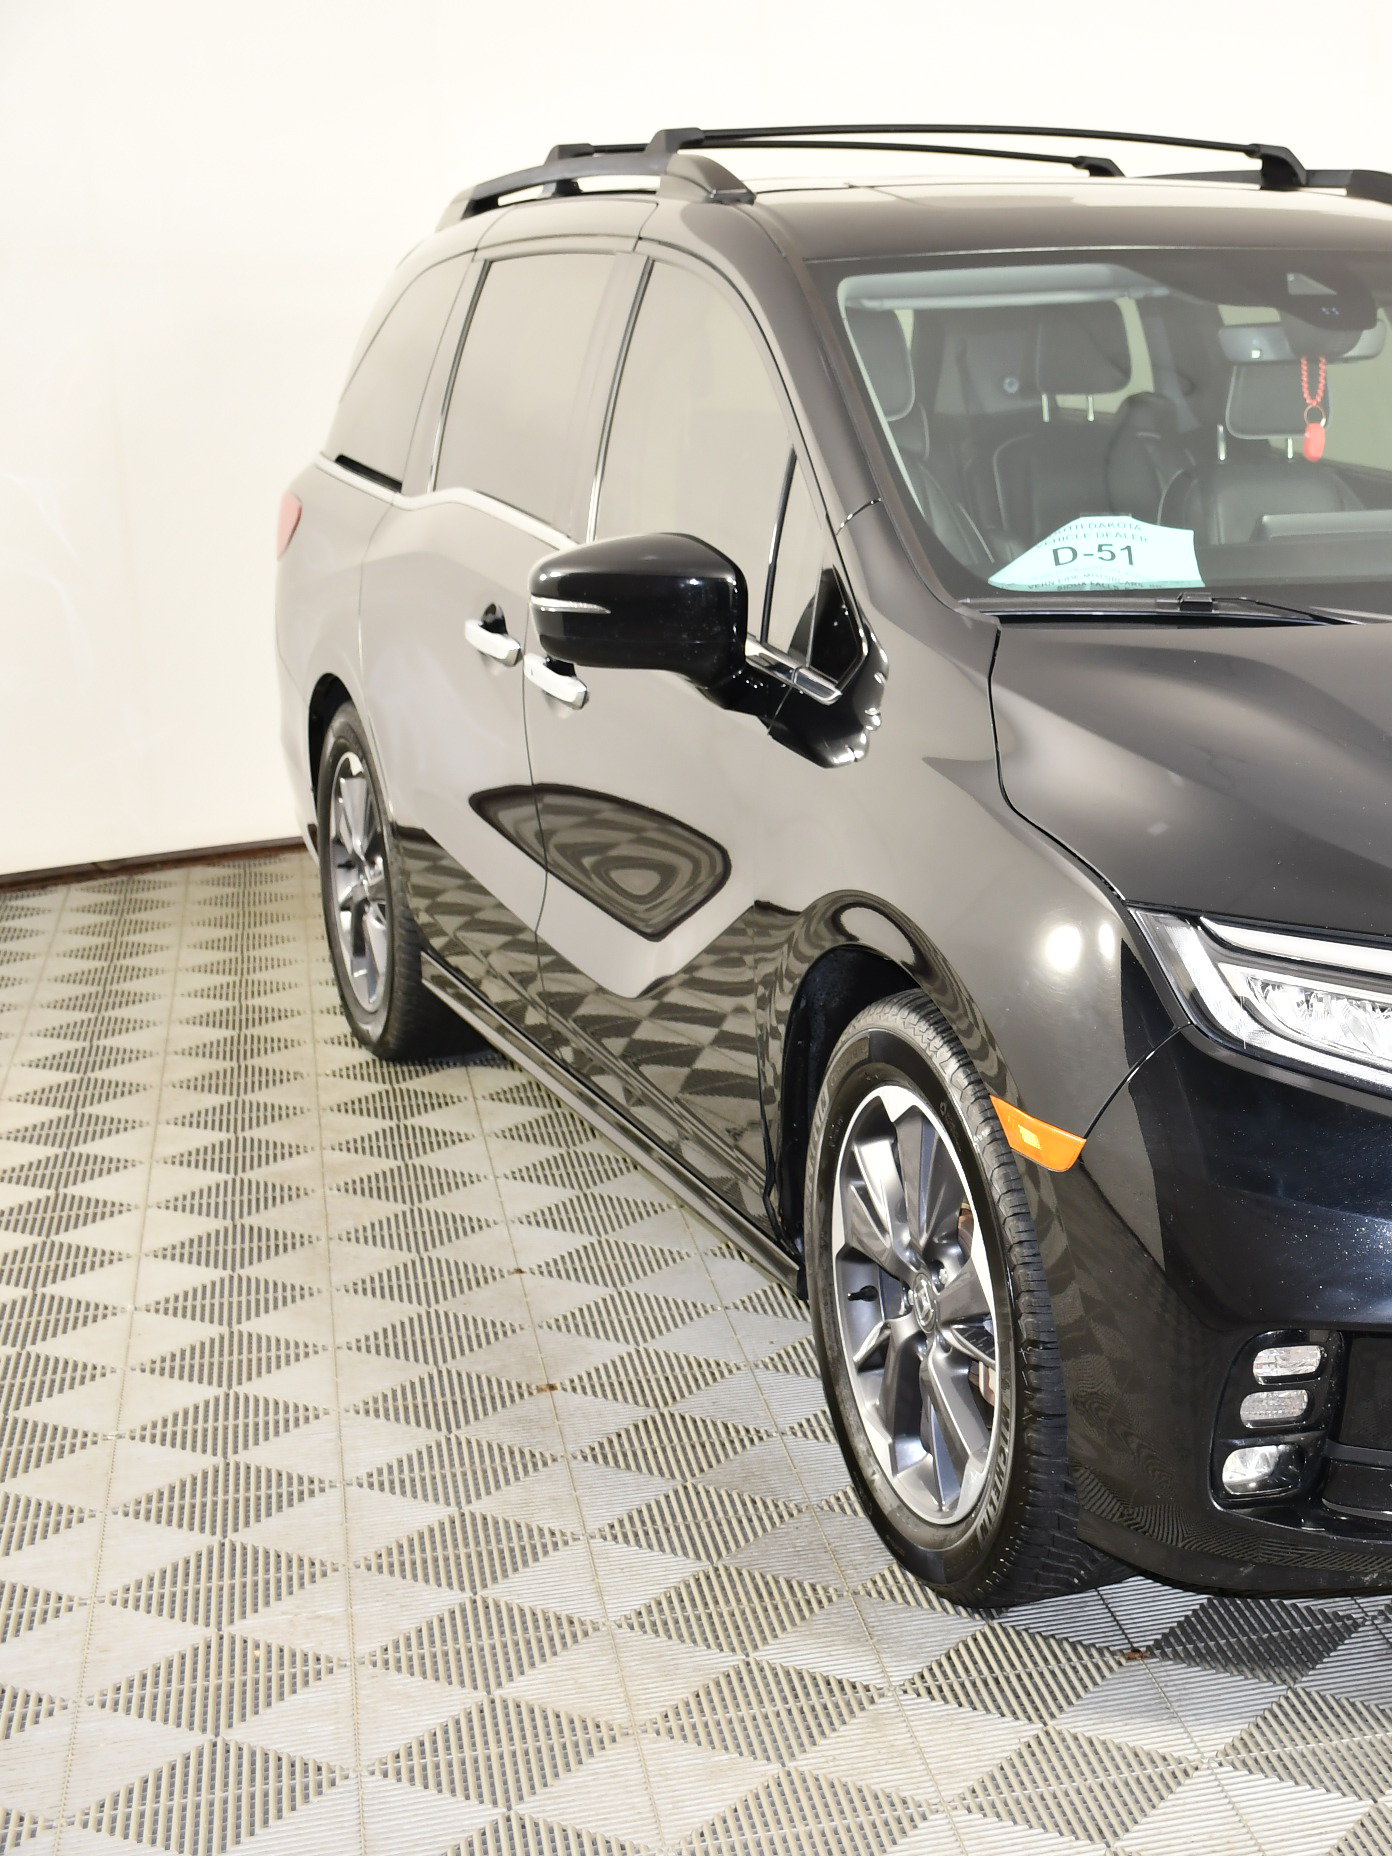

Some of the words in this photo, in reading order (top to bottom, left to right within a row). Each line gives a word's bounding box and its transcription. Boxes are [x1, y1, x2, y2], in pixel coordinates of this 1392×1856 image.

[1088, 521, 1141, 531] DAKOTA
[1052, 543, 1134, 567] D-51
[976, 1401, 1010, 1541] MICHELIN
